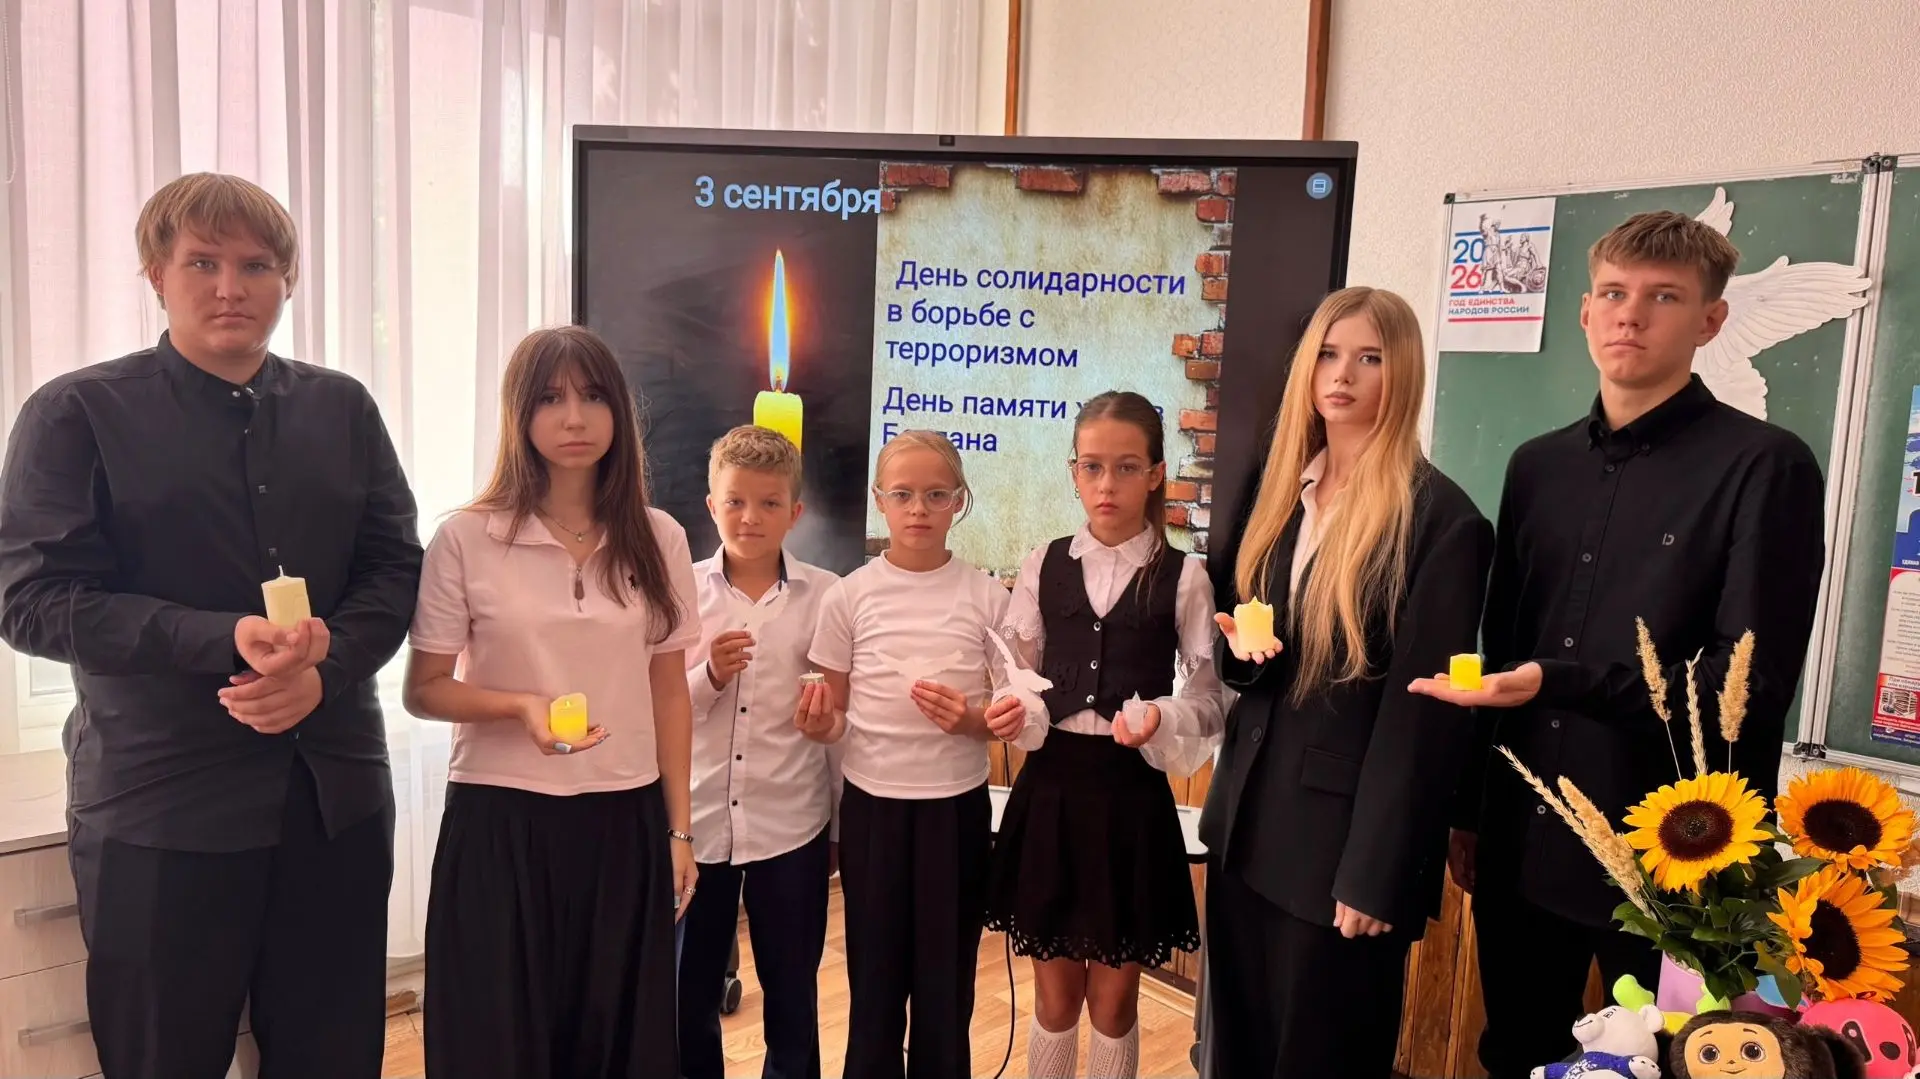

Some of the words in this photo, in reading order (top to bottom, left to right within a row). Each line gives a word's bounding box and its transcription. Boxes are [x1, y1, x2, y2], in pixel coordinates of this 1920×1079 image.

[695, 175, 715, 207] 3
[724, 179, 881, 220] сентября
[1453, 238, 1486, 263] 20
[896, 260, 968, 290] День
[977, 268, 1186, 297] солидарности
[1451, 264, 1482, 288] 26
[887, 304, 903, 322] в
[911, 299, 1011, 331] борьбе
[1019, 309, 1036, 328] с
[1448, 307, 1489, 315] НАРОДОВ
[1491, 306, 1529, 314] РОССИИ
[1468, 298, 1516, 306] ЕДИНСТВА
[885, 340, 1079, 368] терроризмом
[882, 387, 954, 415] День
[962, 396, 1067, 419] памяти
[882, 422, 998, 452] Бана
